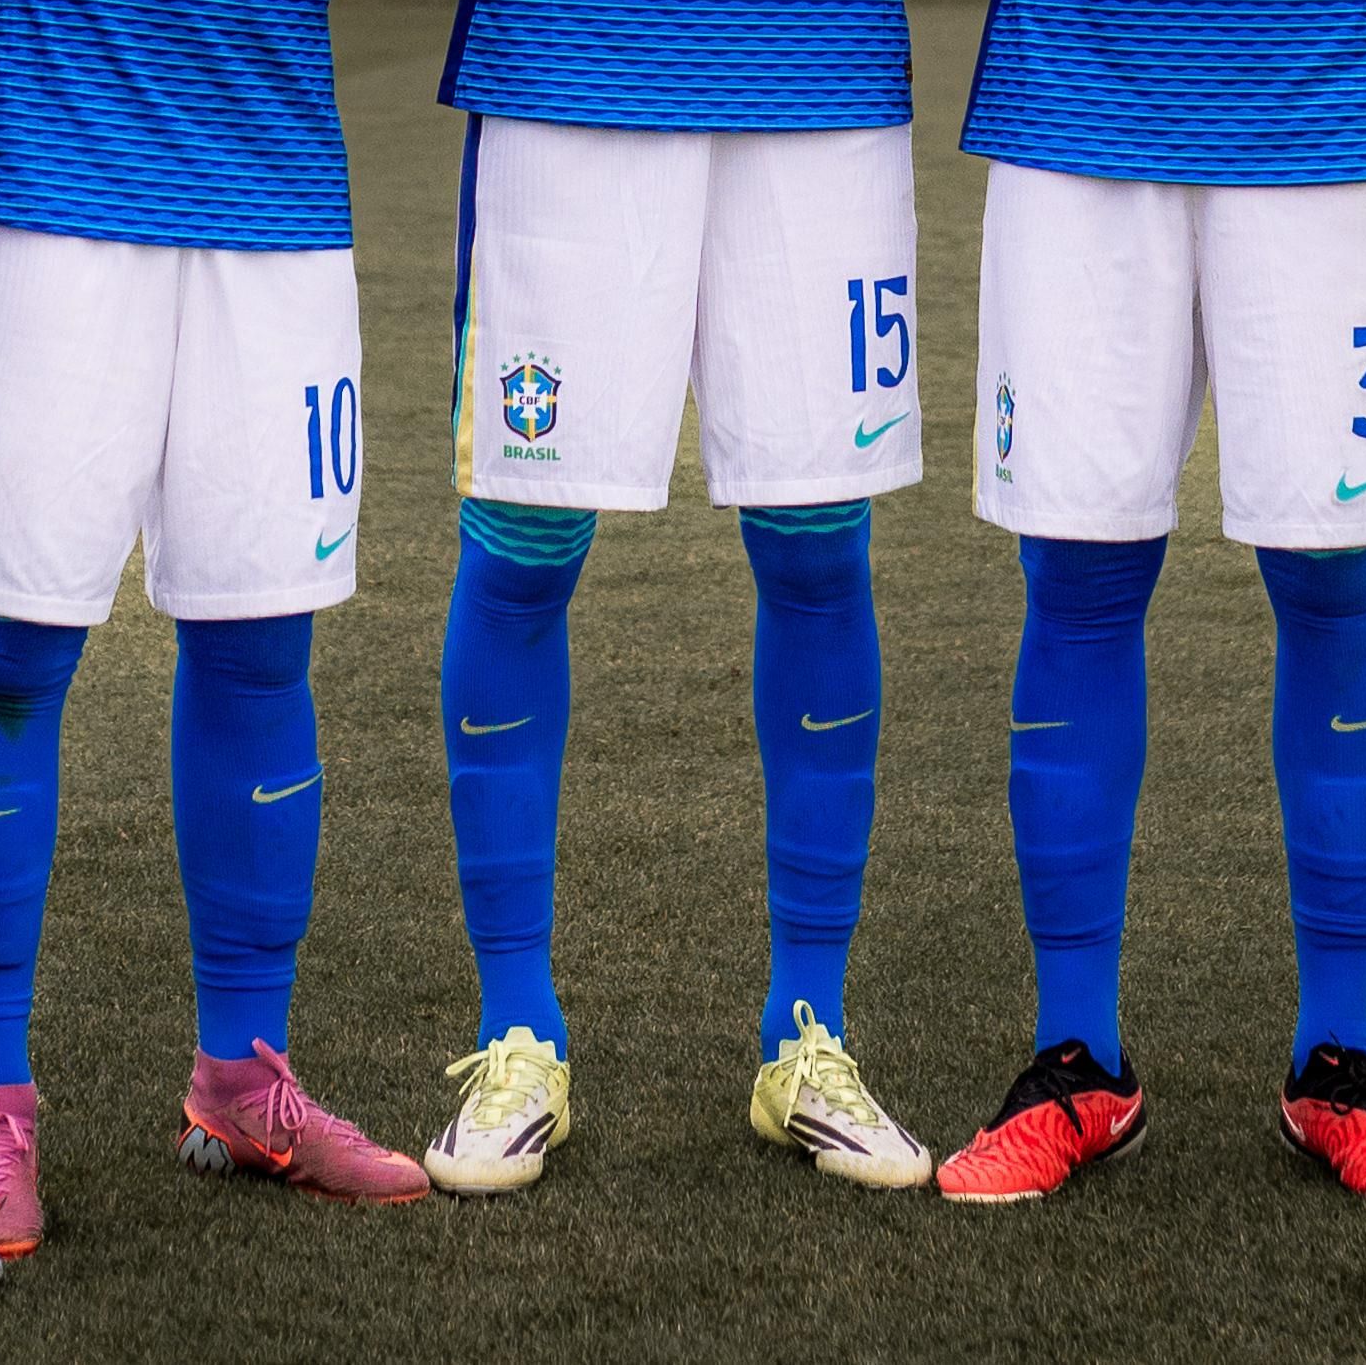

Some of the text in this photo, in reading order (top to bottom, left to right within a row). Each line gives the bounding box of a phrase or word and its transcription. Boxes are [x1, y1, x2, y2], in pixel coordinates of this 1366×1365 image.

[847, 275, 911, 393] 15
[519, 396, 541, 405] CBF
[304, 377, 356, 499] 10
[503, 445, 561, 461] BRASIL
